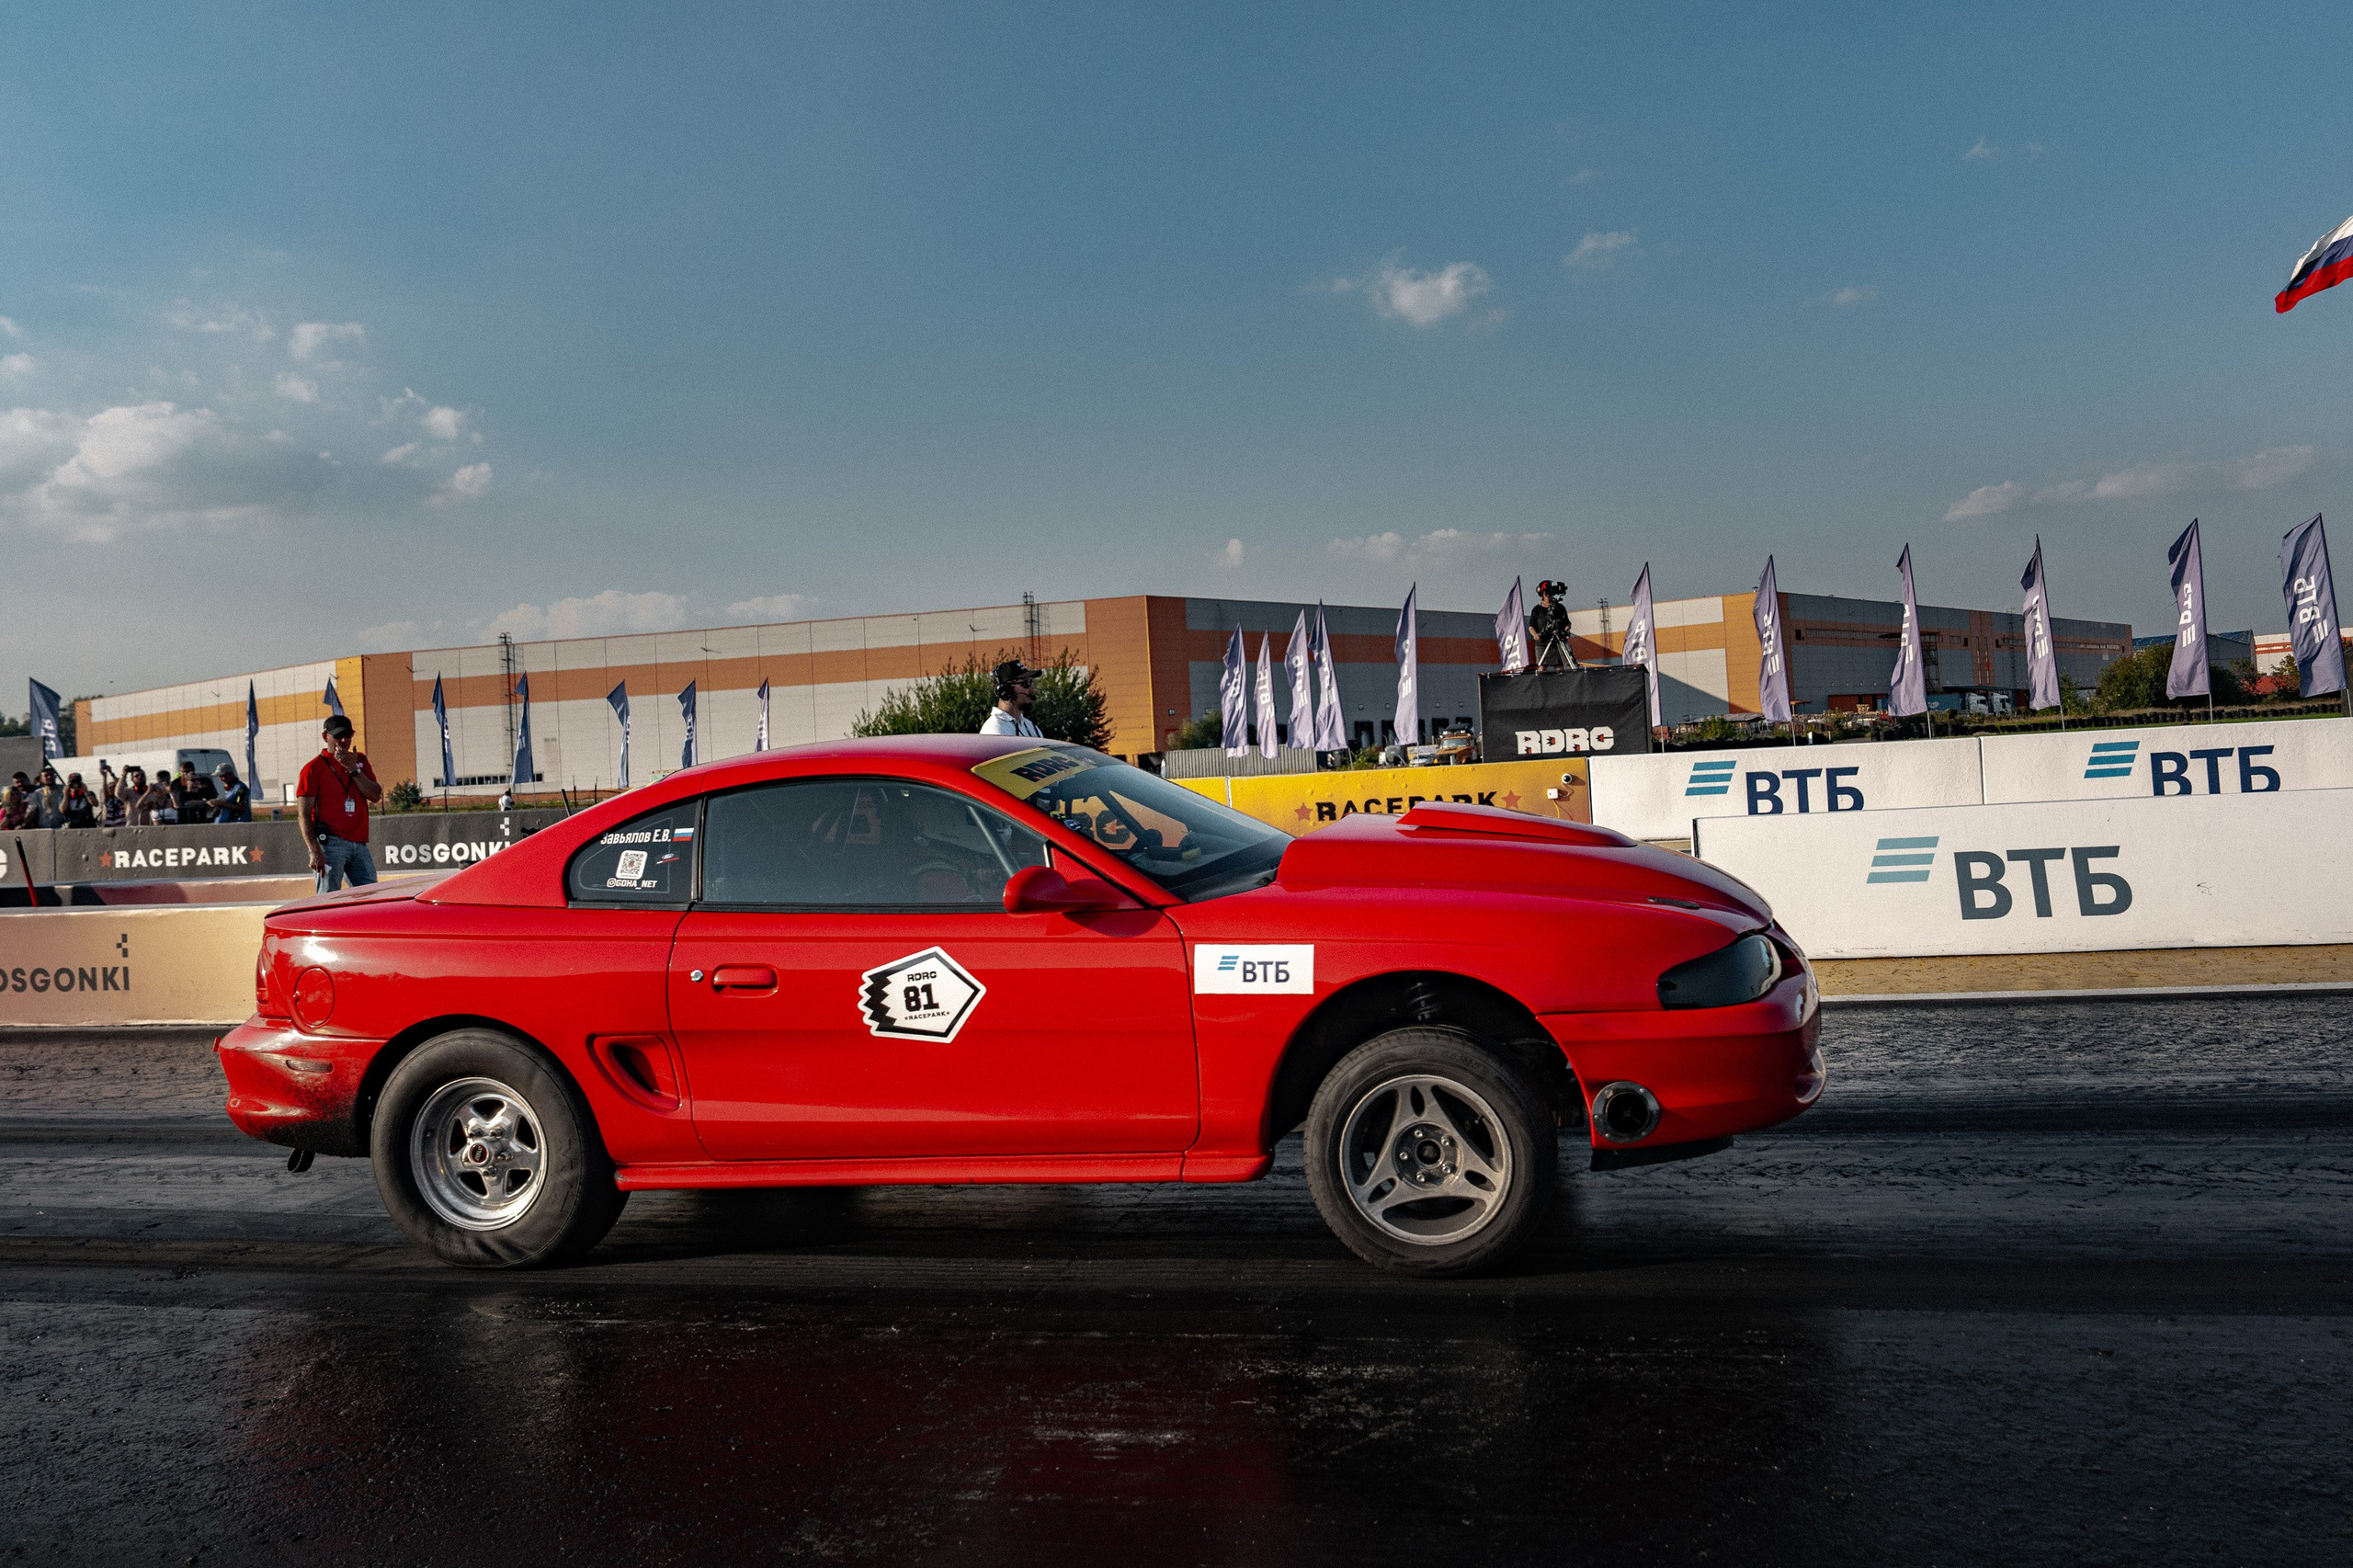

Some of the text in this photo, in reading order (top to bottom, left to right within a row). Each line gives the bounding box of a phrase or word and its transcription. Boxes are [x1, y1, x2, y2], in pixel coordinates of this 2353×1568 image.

[1515, 726, 1614, 755] RDRC
[2150, 744, 2281, 797] ВТБ
[1745, 767, 1864, 815] ВТБ
[114, 846, 248, 869] RACEPARK
[1954, 845, 2132, 921] ВТБ
[907, 971, 938, 982] RDRC
[1243, 960, 1290, 983] ВТБ
[904, 983, 939, 1012] 81
[908, 1011, 947, 1020] RACEPARK
